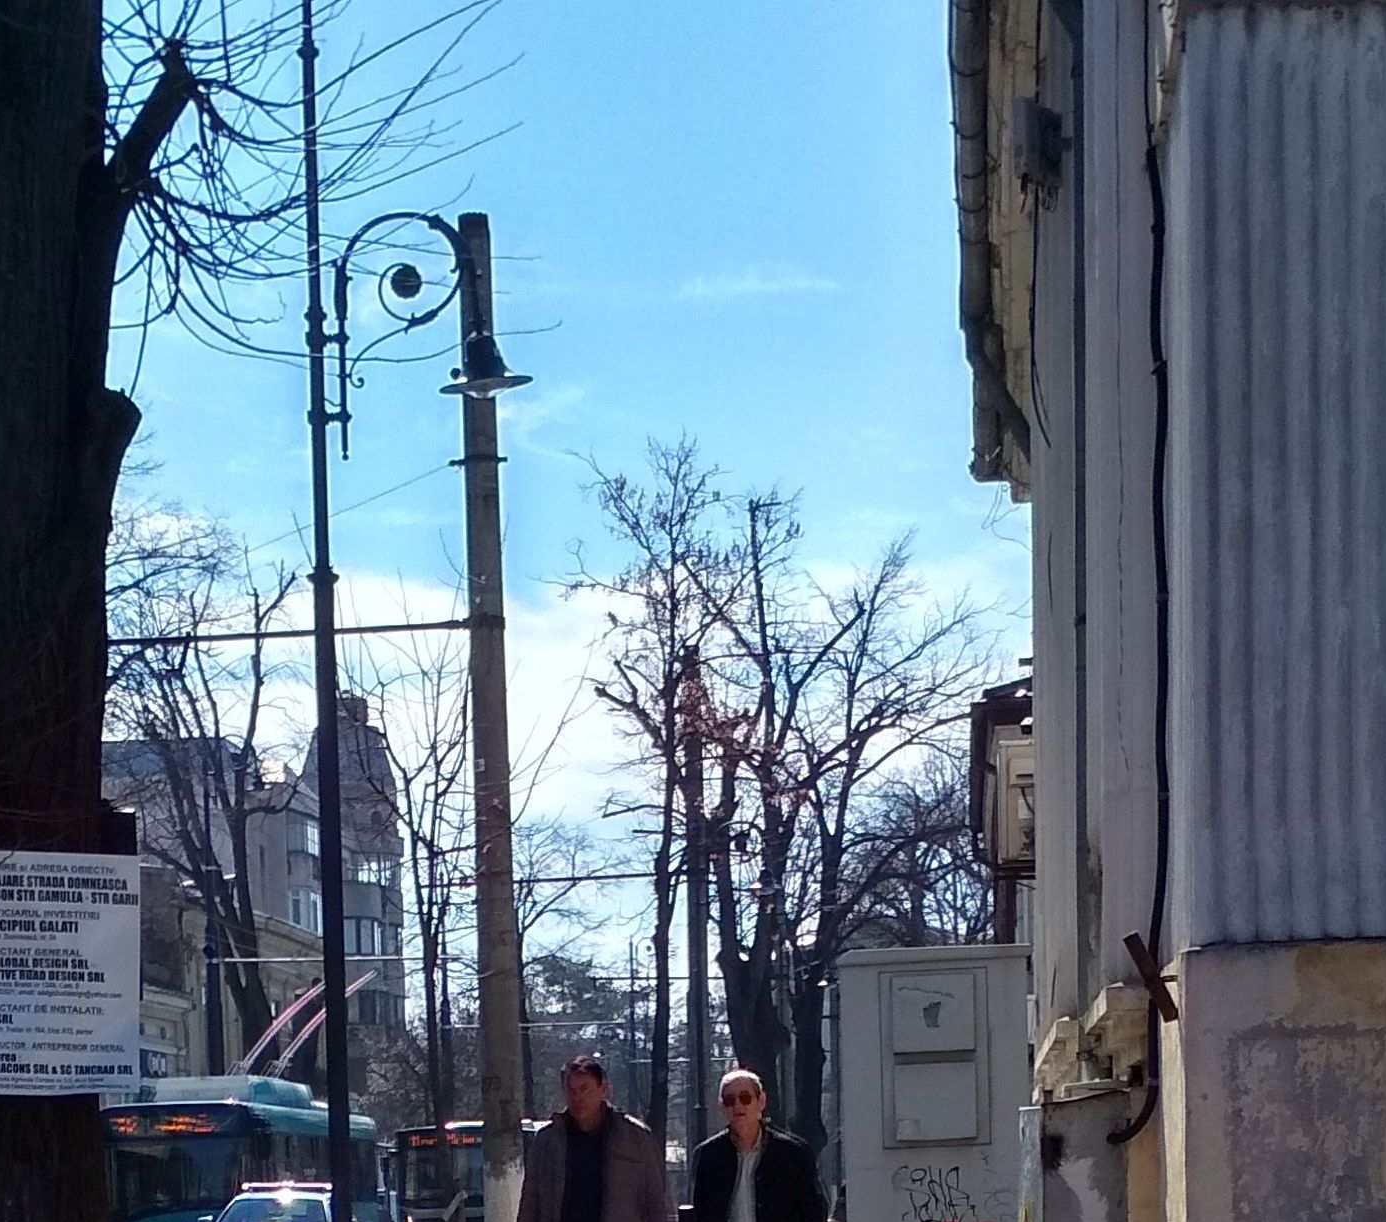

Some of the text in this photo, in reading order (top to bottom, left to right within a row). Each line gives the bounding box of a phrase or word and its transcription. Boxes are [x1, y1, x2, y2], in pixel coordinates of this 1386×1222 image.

[30, 863, 69, 874] ADRESA
[26, 875, 66, 889] STRADA
[67, 876, 128, 891] DOMNEASCA
[16, 888, 35, 902] STR
[37, 889, 84, 904] GAMULEA
[90, 891, 110, 906] STR
[111, 892, 139, 907] GARII
[39, 920, 79, 934] GALATI
[34, 948, 82, 958] GENERAL
[32, 958, 69, 970] DESIGN
[71, 960, 89, 971] SRL
[19, 969, 46, 981] ROAD
[48, 971, 85, 983] DESIGN
[87, 972, 106, 984] SRL
[34, 1004, 49, 1014] DE
[31, 1042, 88, 1052] ANTREPRENOR
[89, 1044, 125, 1054] GENERAL
[33, 1063, 50, 1075] SRL
[51, 1066, 58, 1075] &
[59, 1064, 73, 1076] SC
[74, 1065, 115, 1076] TANCRAD
[117, 1065, 133, 1076] SRL
